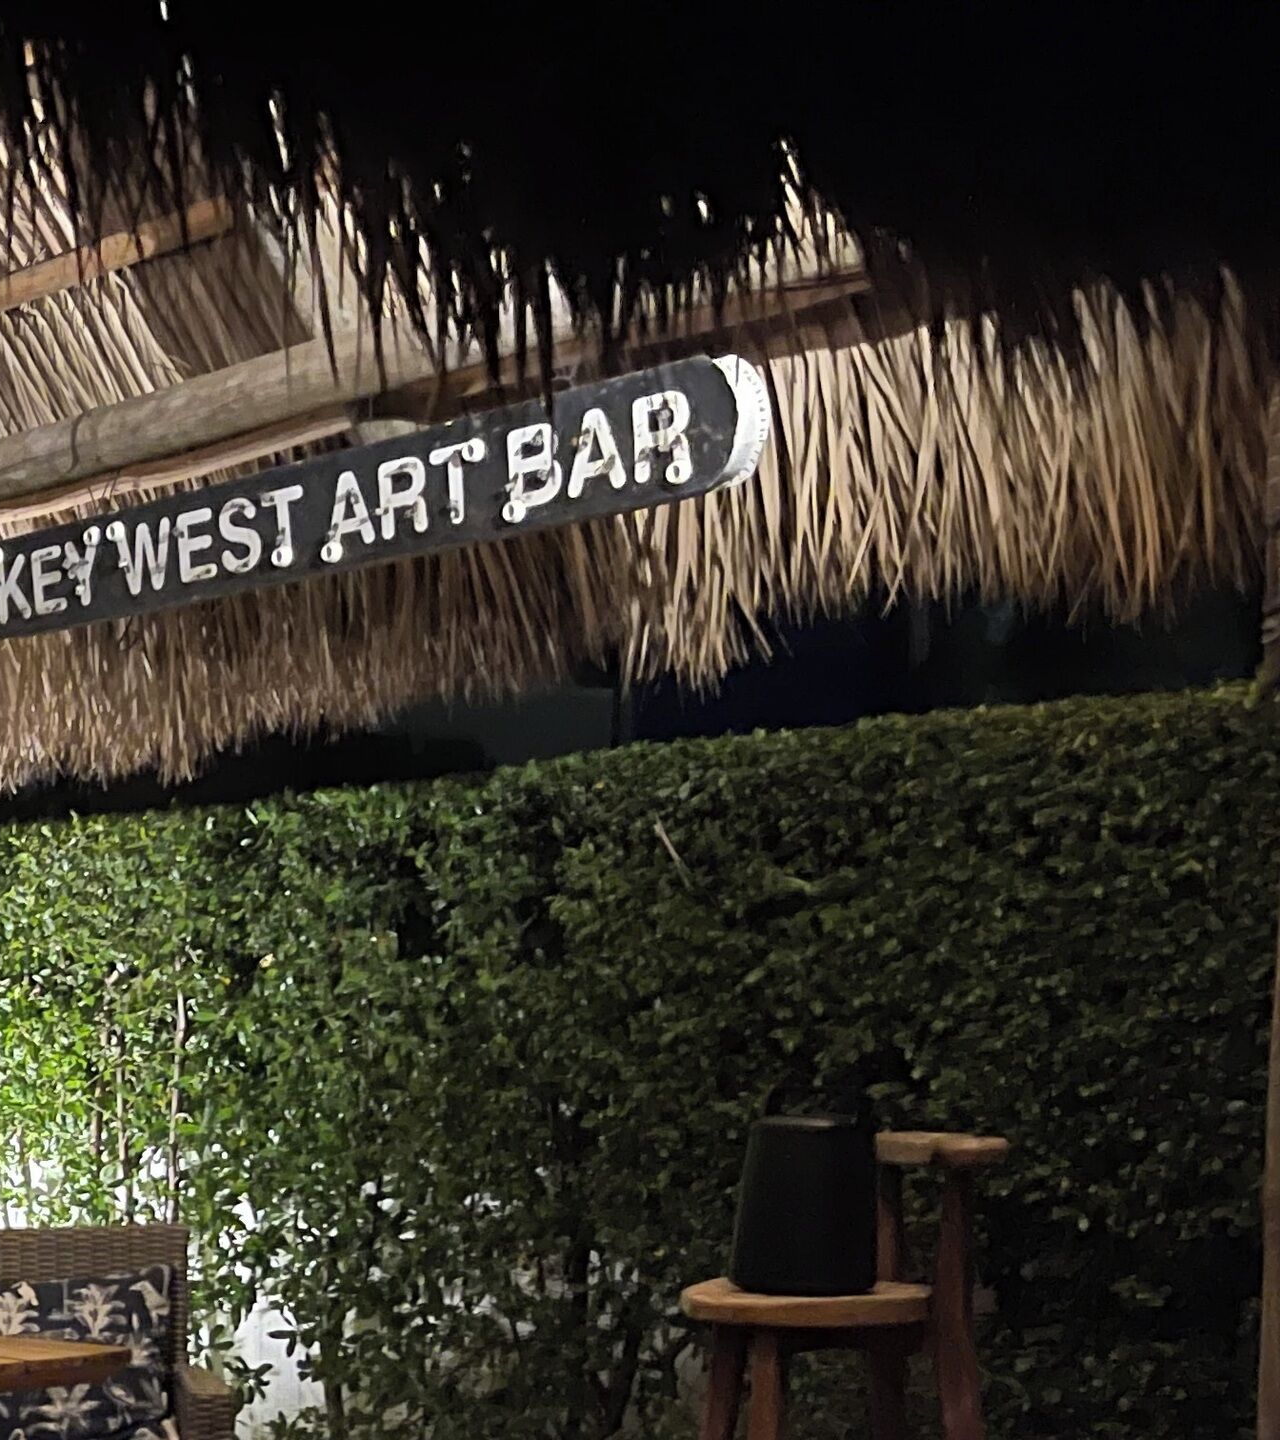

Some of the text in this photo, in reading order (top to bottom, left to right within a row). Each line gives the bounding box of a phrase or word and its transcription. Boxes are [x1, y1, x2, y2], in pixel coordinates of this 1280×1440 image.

[107, 484, 303, 595] WEST
[320, 436, 486, 564] ART
[502, 390, 693, 524] BAR
